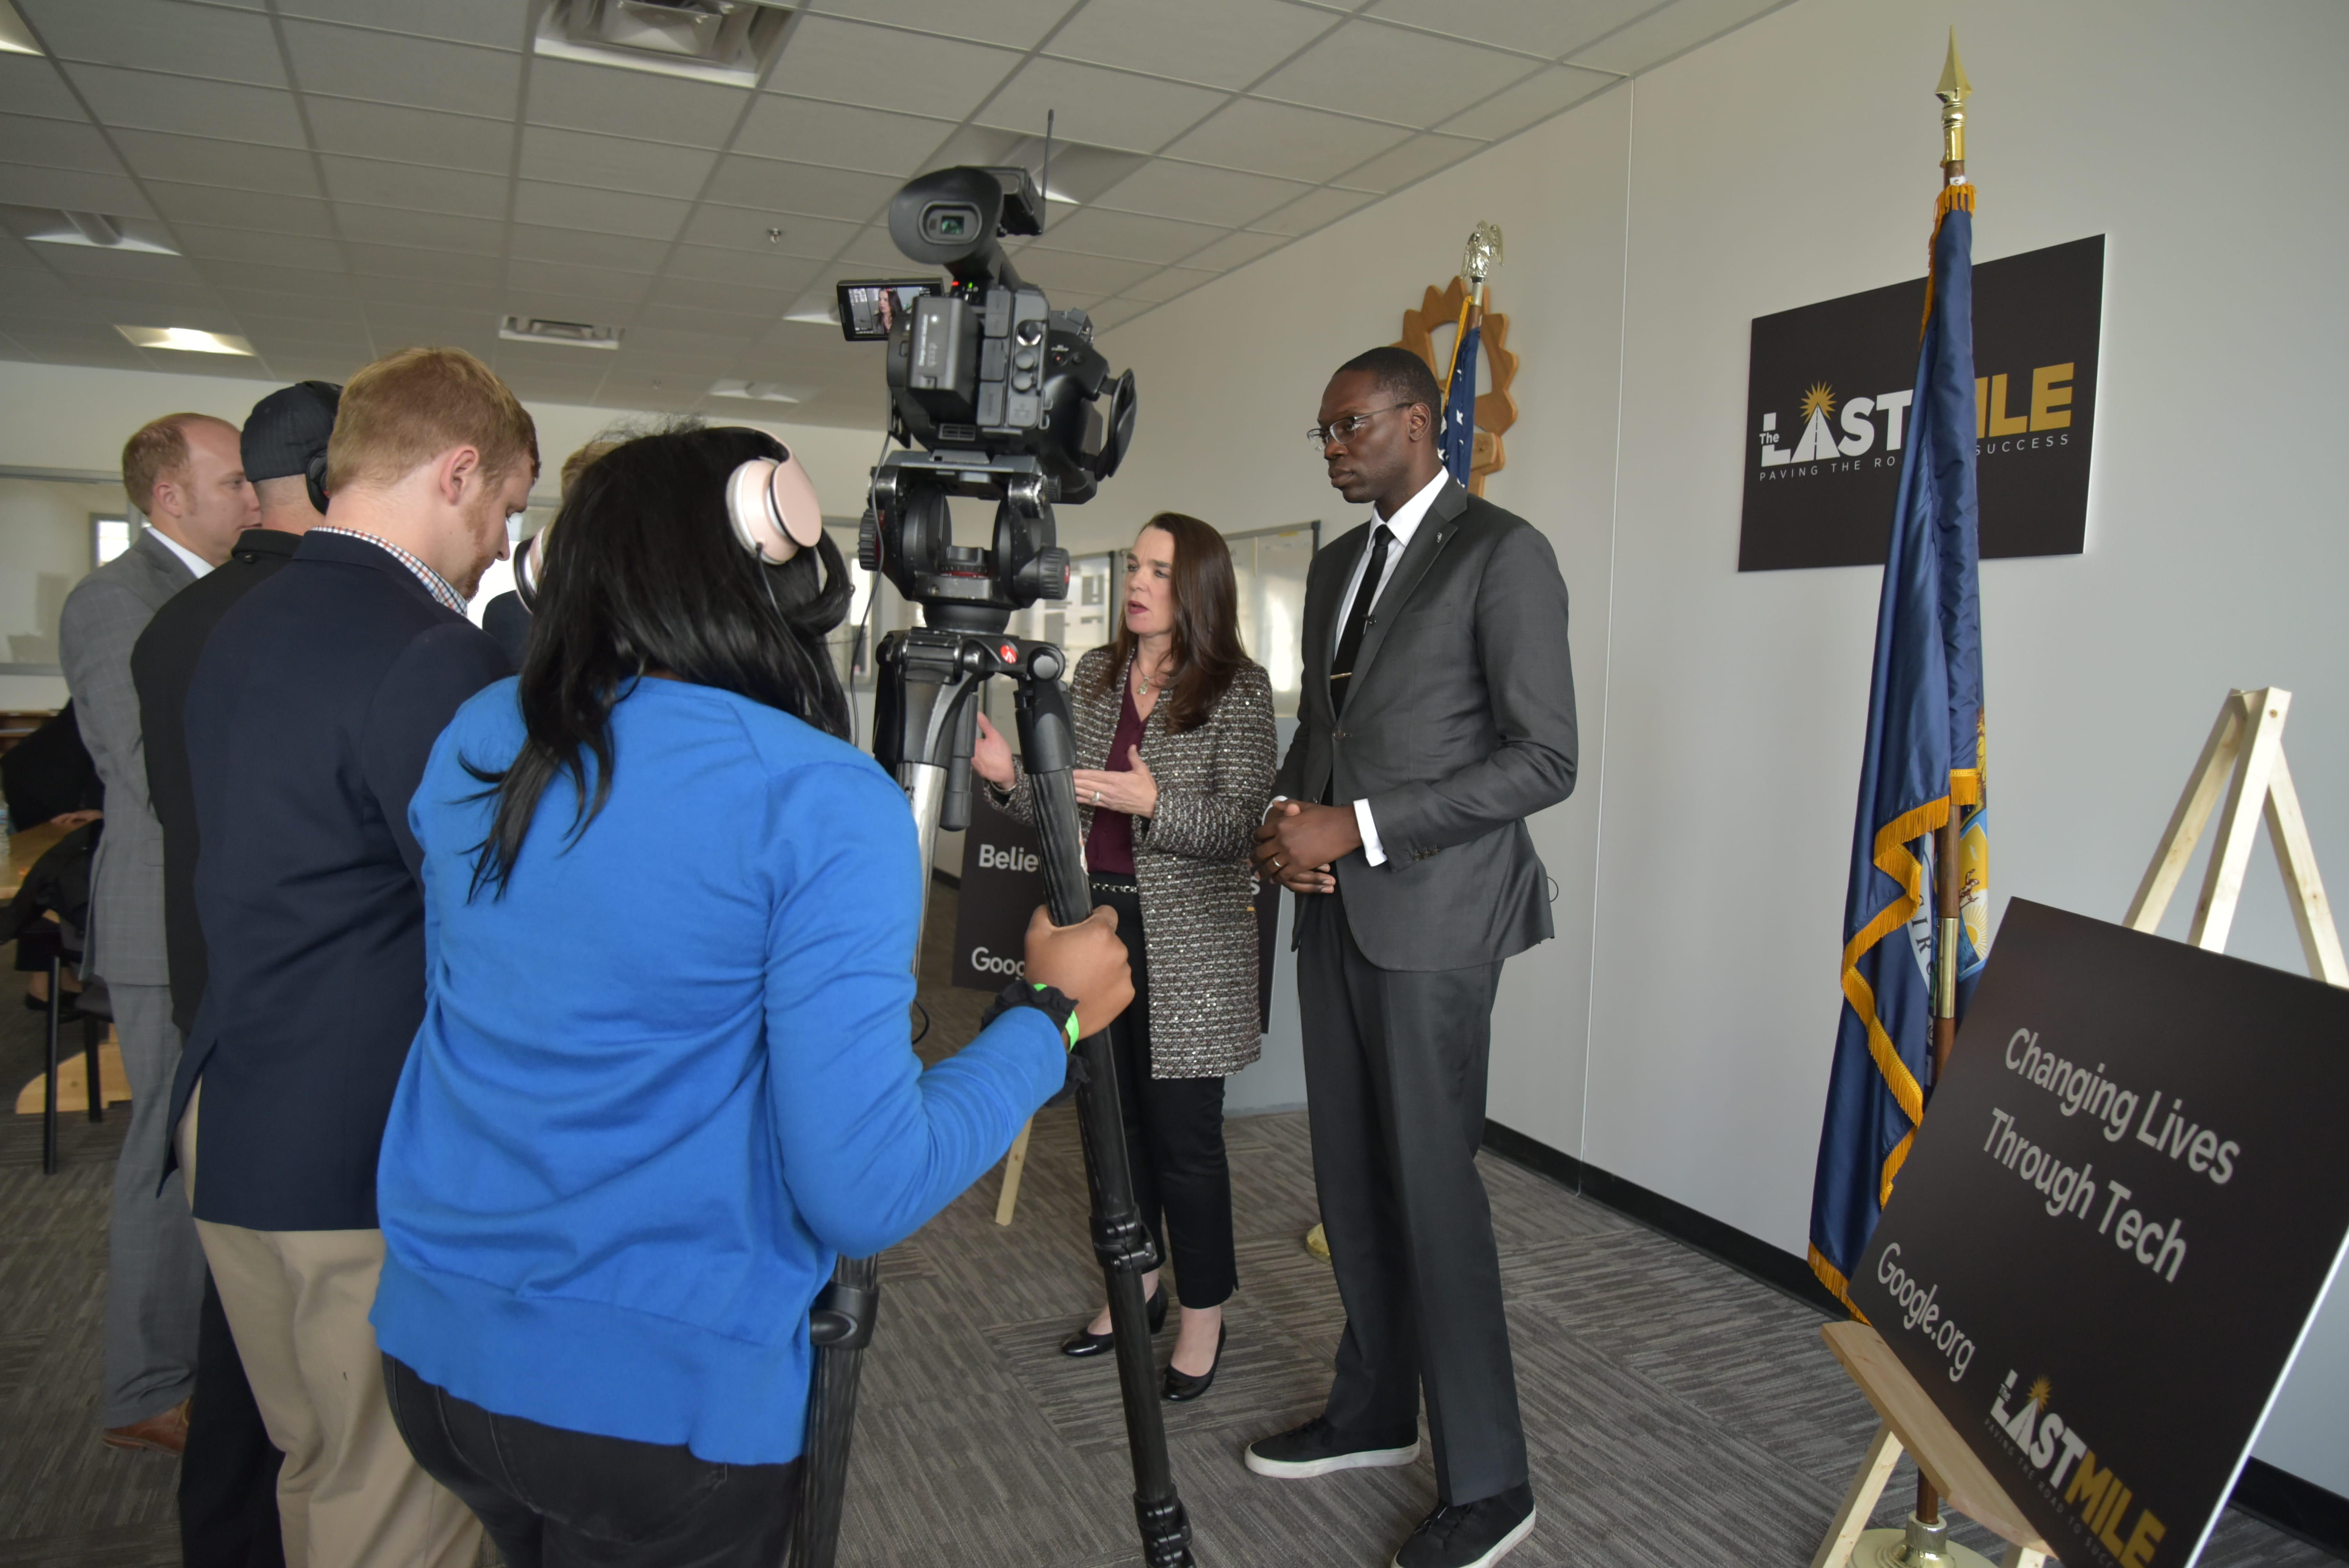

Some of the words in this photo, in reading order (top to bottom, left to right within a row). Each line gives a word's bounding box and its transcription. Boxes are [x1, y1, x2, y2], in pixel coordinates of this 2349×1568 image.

[1759, 432, 1779, 445] The
[1761, 389, 1914, 467] LAST
[1975, 362, 2074, 439] ILE
[1760, 465, 1818, 481] PAVING
[1831, 460, 1861, 473] THE
[1875, 456, 1896, 468] RO
[1976, 434, 2068, 456] SUCCESS
[978, 844, 1040, 872] Belie
[2005, 1028, 2139, 1142] Changing
[2136, 1091, 2240, 1185] Lives
[1984, 1107, 2096, 1217] Through
[2098, 1180, 2187, 1283] Tech
[1877, 1242, 1976, 1383] Google.org
[1998, 1383, 2011, 1402] The
[1984, 1418, 2014, 1455] PAVING
[2018, 1457, 2035, 1479] THE
[2038, 1481, 2064, 1513] ROAD
[2069, 1516, 2081, 1534] TO
